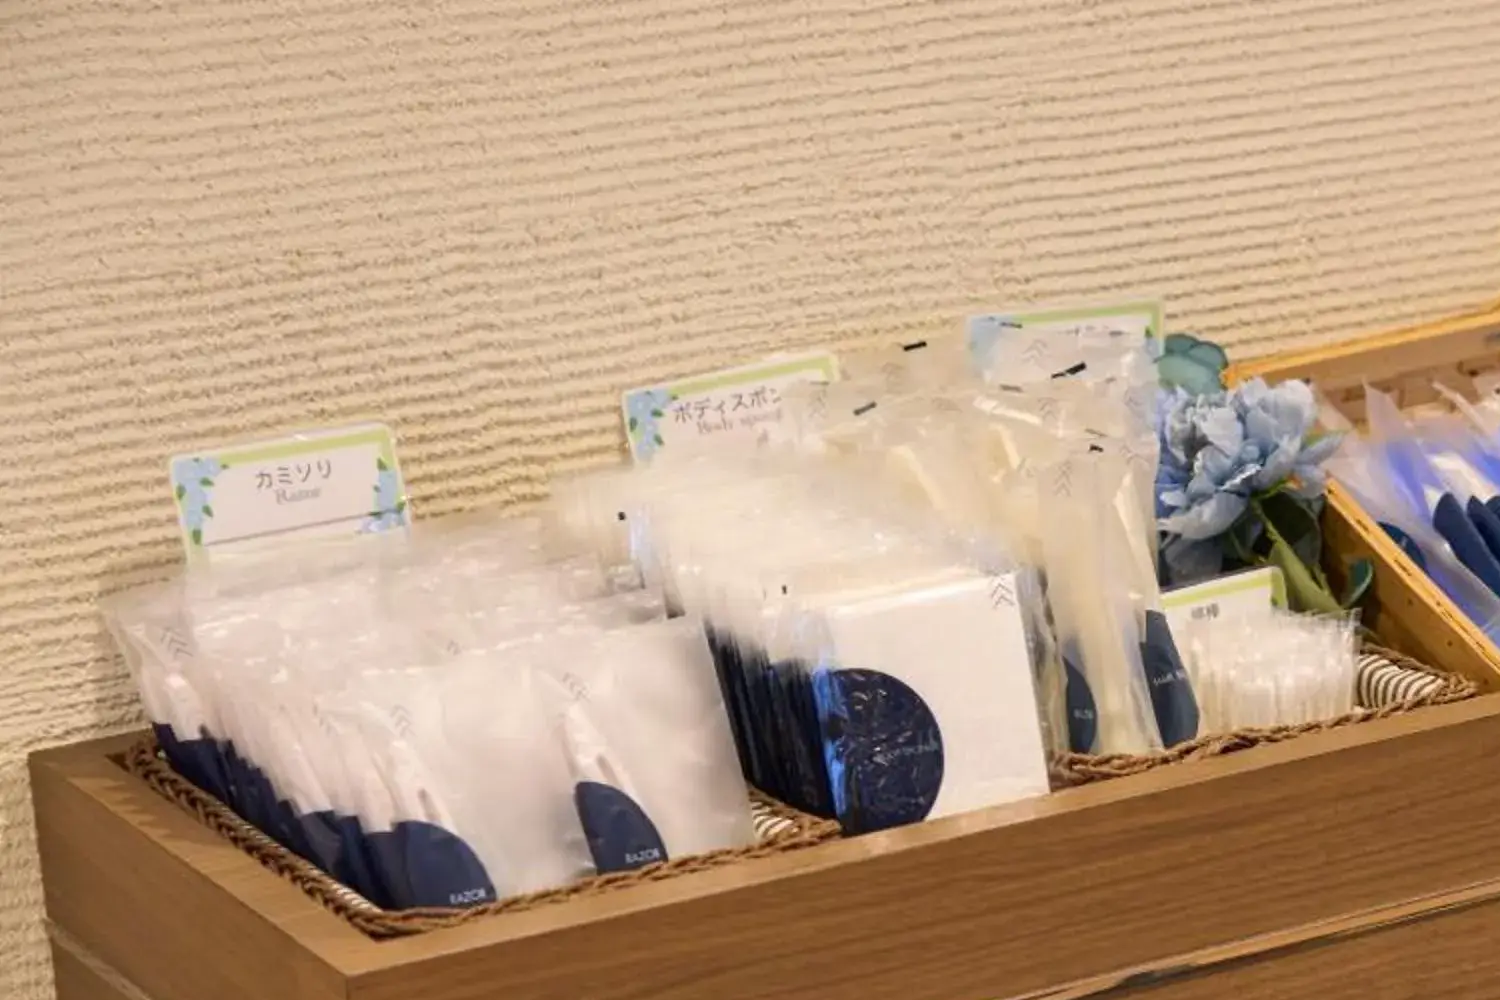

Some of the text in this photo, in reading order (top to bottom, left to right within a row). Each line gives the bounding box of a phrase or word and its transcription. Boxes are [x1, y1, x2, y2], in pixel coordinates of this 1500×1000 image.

[674, 384, 783, 424] ボディスポン
[255, 458, 332, 490] カミソリ
[625, 847, 661, 864] RAZOR
[450, 888, 487, 904] RAZOR
